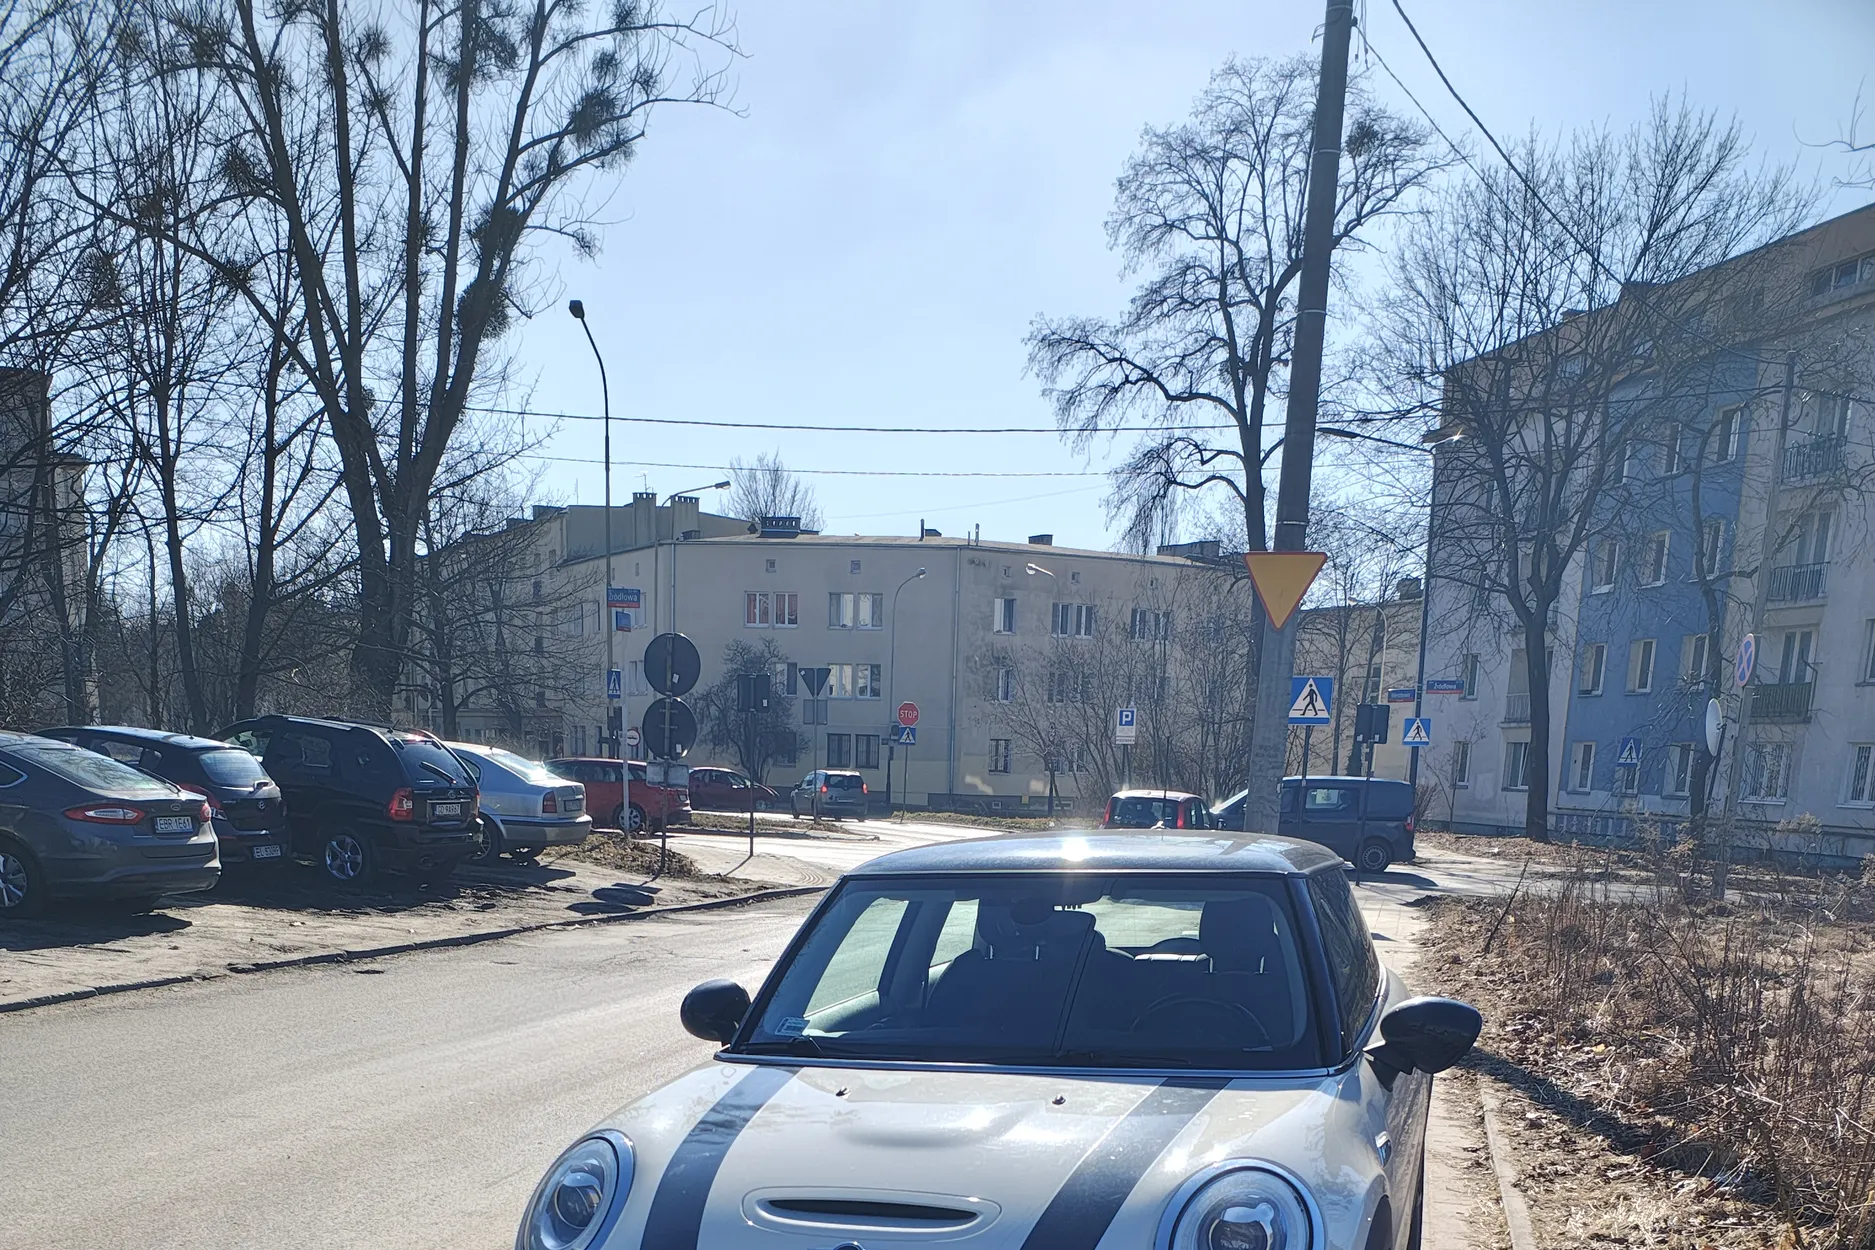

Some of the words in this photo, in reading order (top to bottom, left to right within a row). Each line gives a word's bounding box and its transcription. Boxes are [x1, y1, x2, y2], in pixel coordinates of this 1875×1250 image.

[900, 710, 918, 718] STOP
[1122, 711, 1132, 725] P
[159, 818, 173, 830] EBR
[174, 817, 191, 829] 1E61
